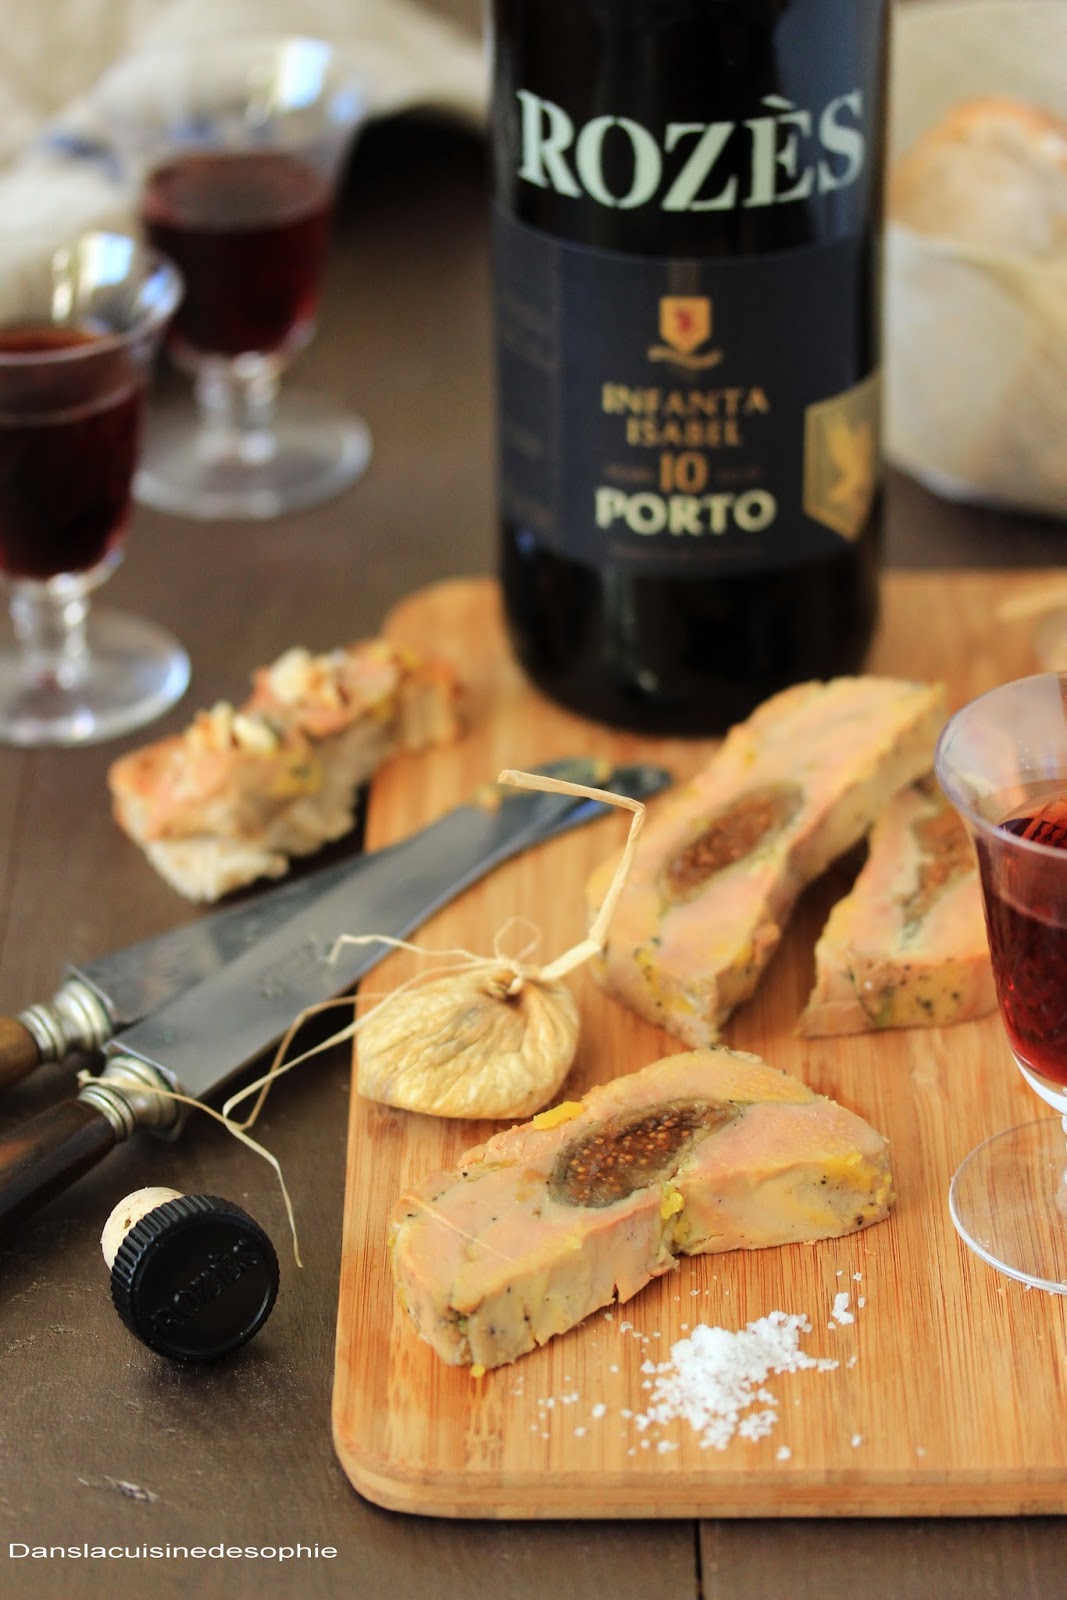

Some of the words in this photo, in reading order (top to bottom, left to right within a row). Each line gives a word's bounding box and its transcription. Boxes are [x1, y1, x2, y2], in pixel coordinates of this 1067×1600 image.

[516, 88, 865, 212] ROZÈS
[602, 383, 769, 414] INFANTA
[659, 451, 708, 494] 10
[595, 487, 777, 536] PORTO
